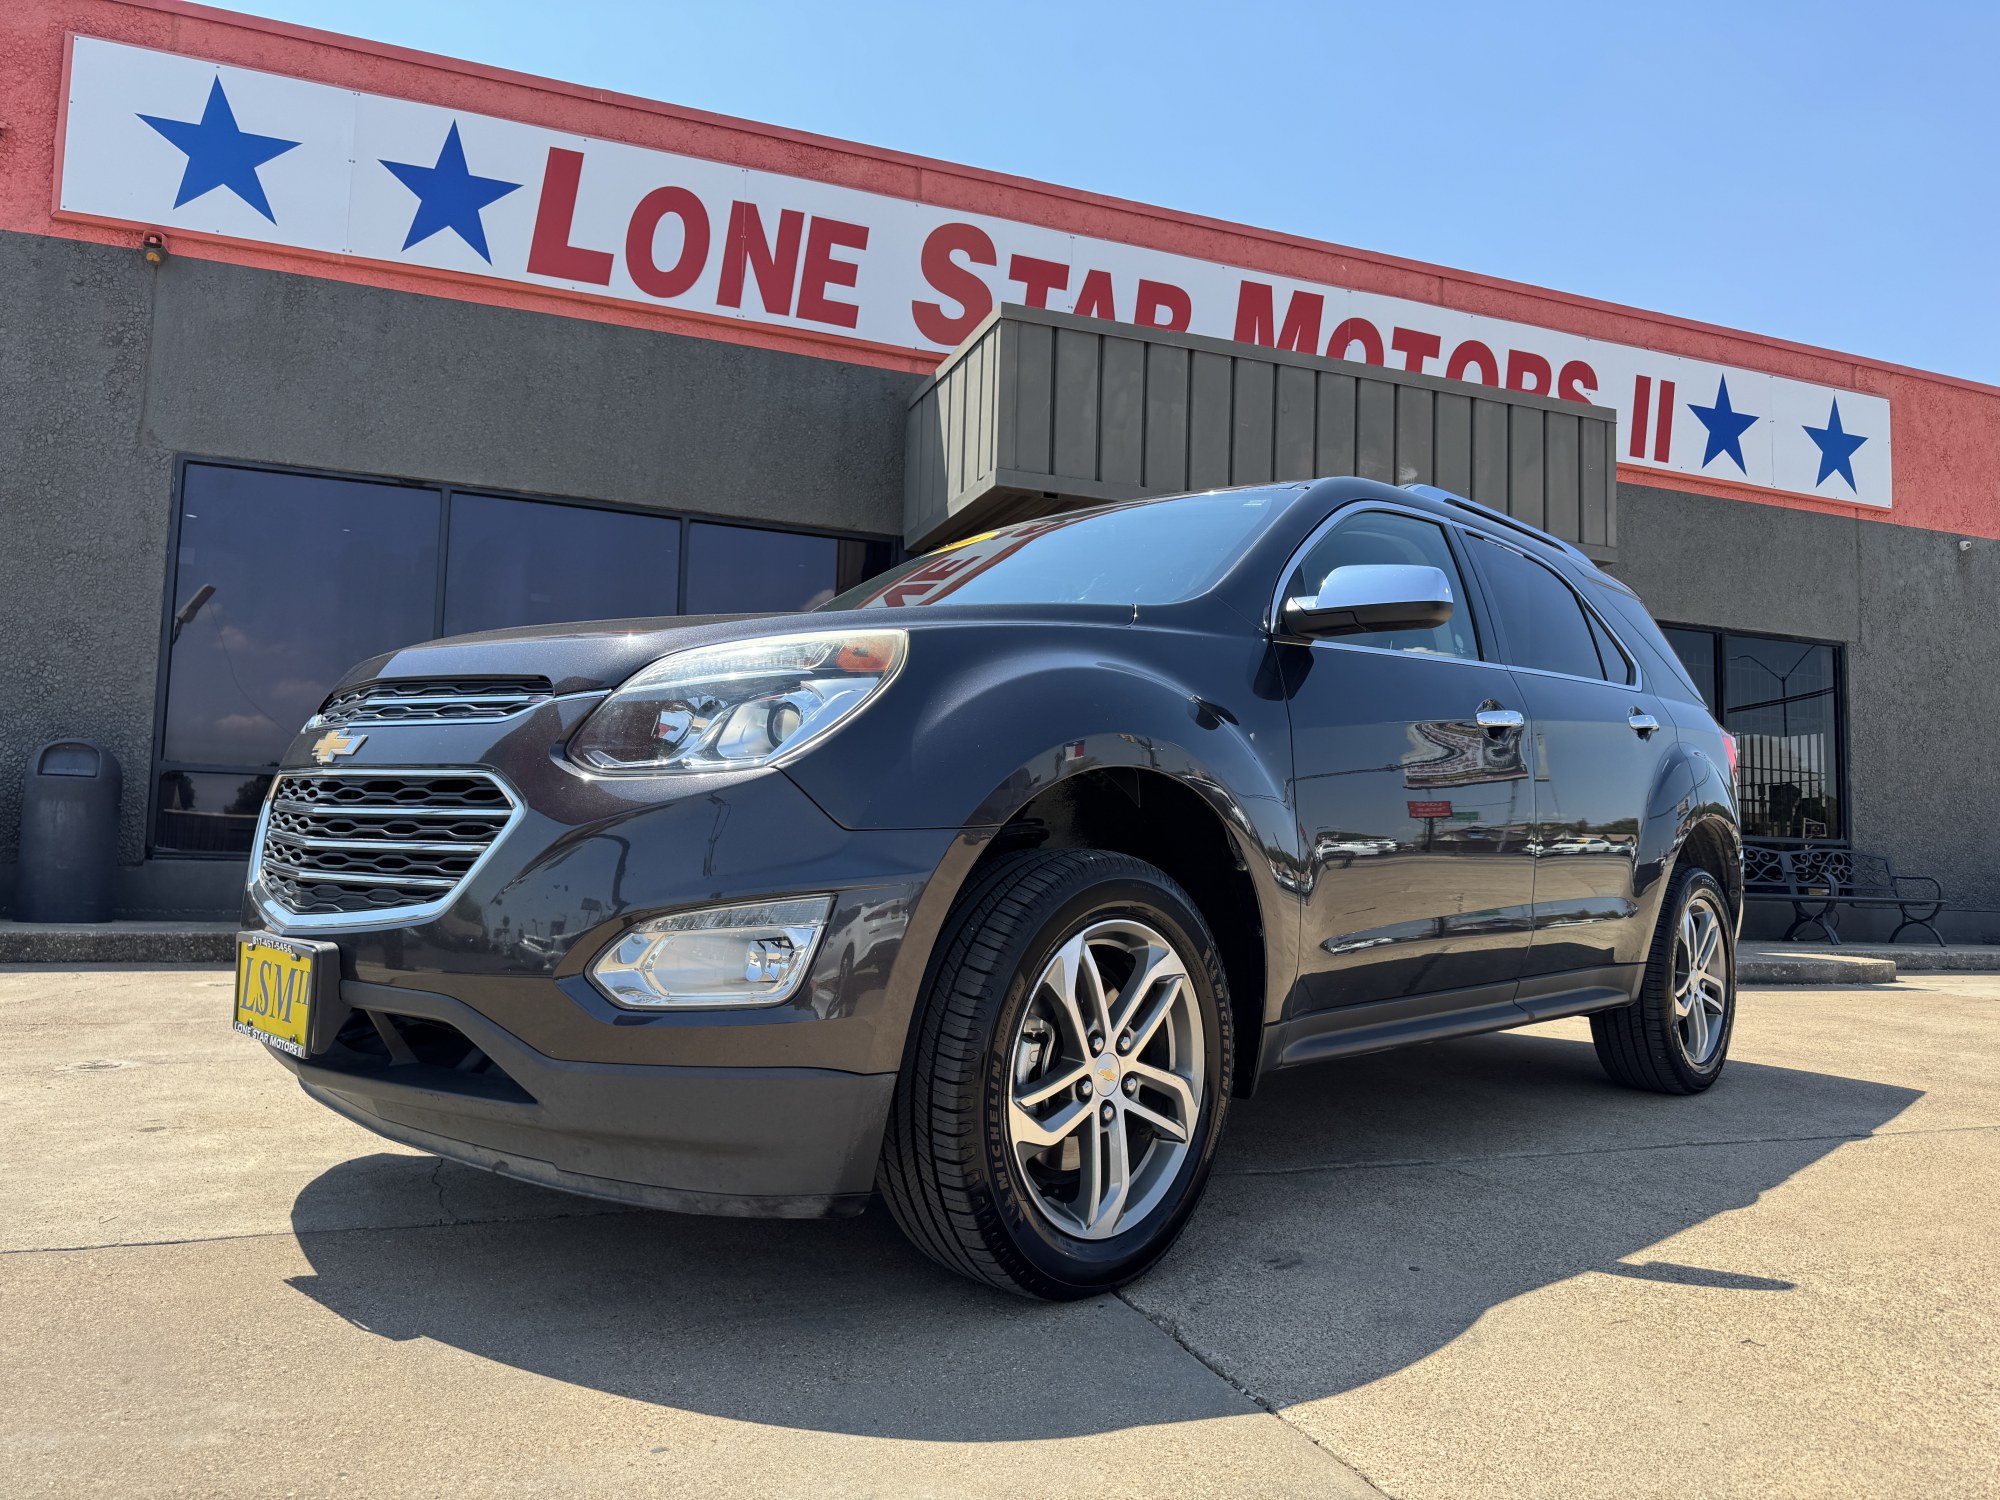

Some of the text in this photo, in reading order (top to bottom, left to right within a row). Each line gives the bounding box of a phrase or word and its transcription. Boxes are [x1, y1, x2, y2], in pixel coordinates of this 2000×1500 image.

[526, 146, 870, 329] LONE
[1629, 375, 1675, 463] II
[234, 1021, 252, 1037] LONE
[253, 1029, 269, 1043] STAR
[269, 1035, 298, 1054] MOTORS
[1214, 983, 1230, 1090] MICHELIN
[989, 1059, 1008, 1190] MICHELIN
